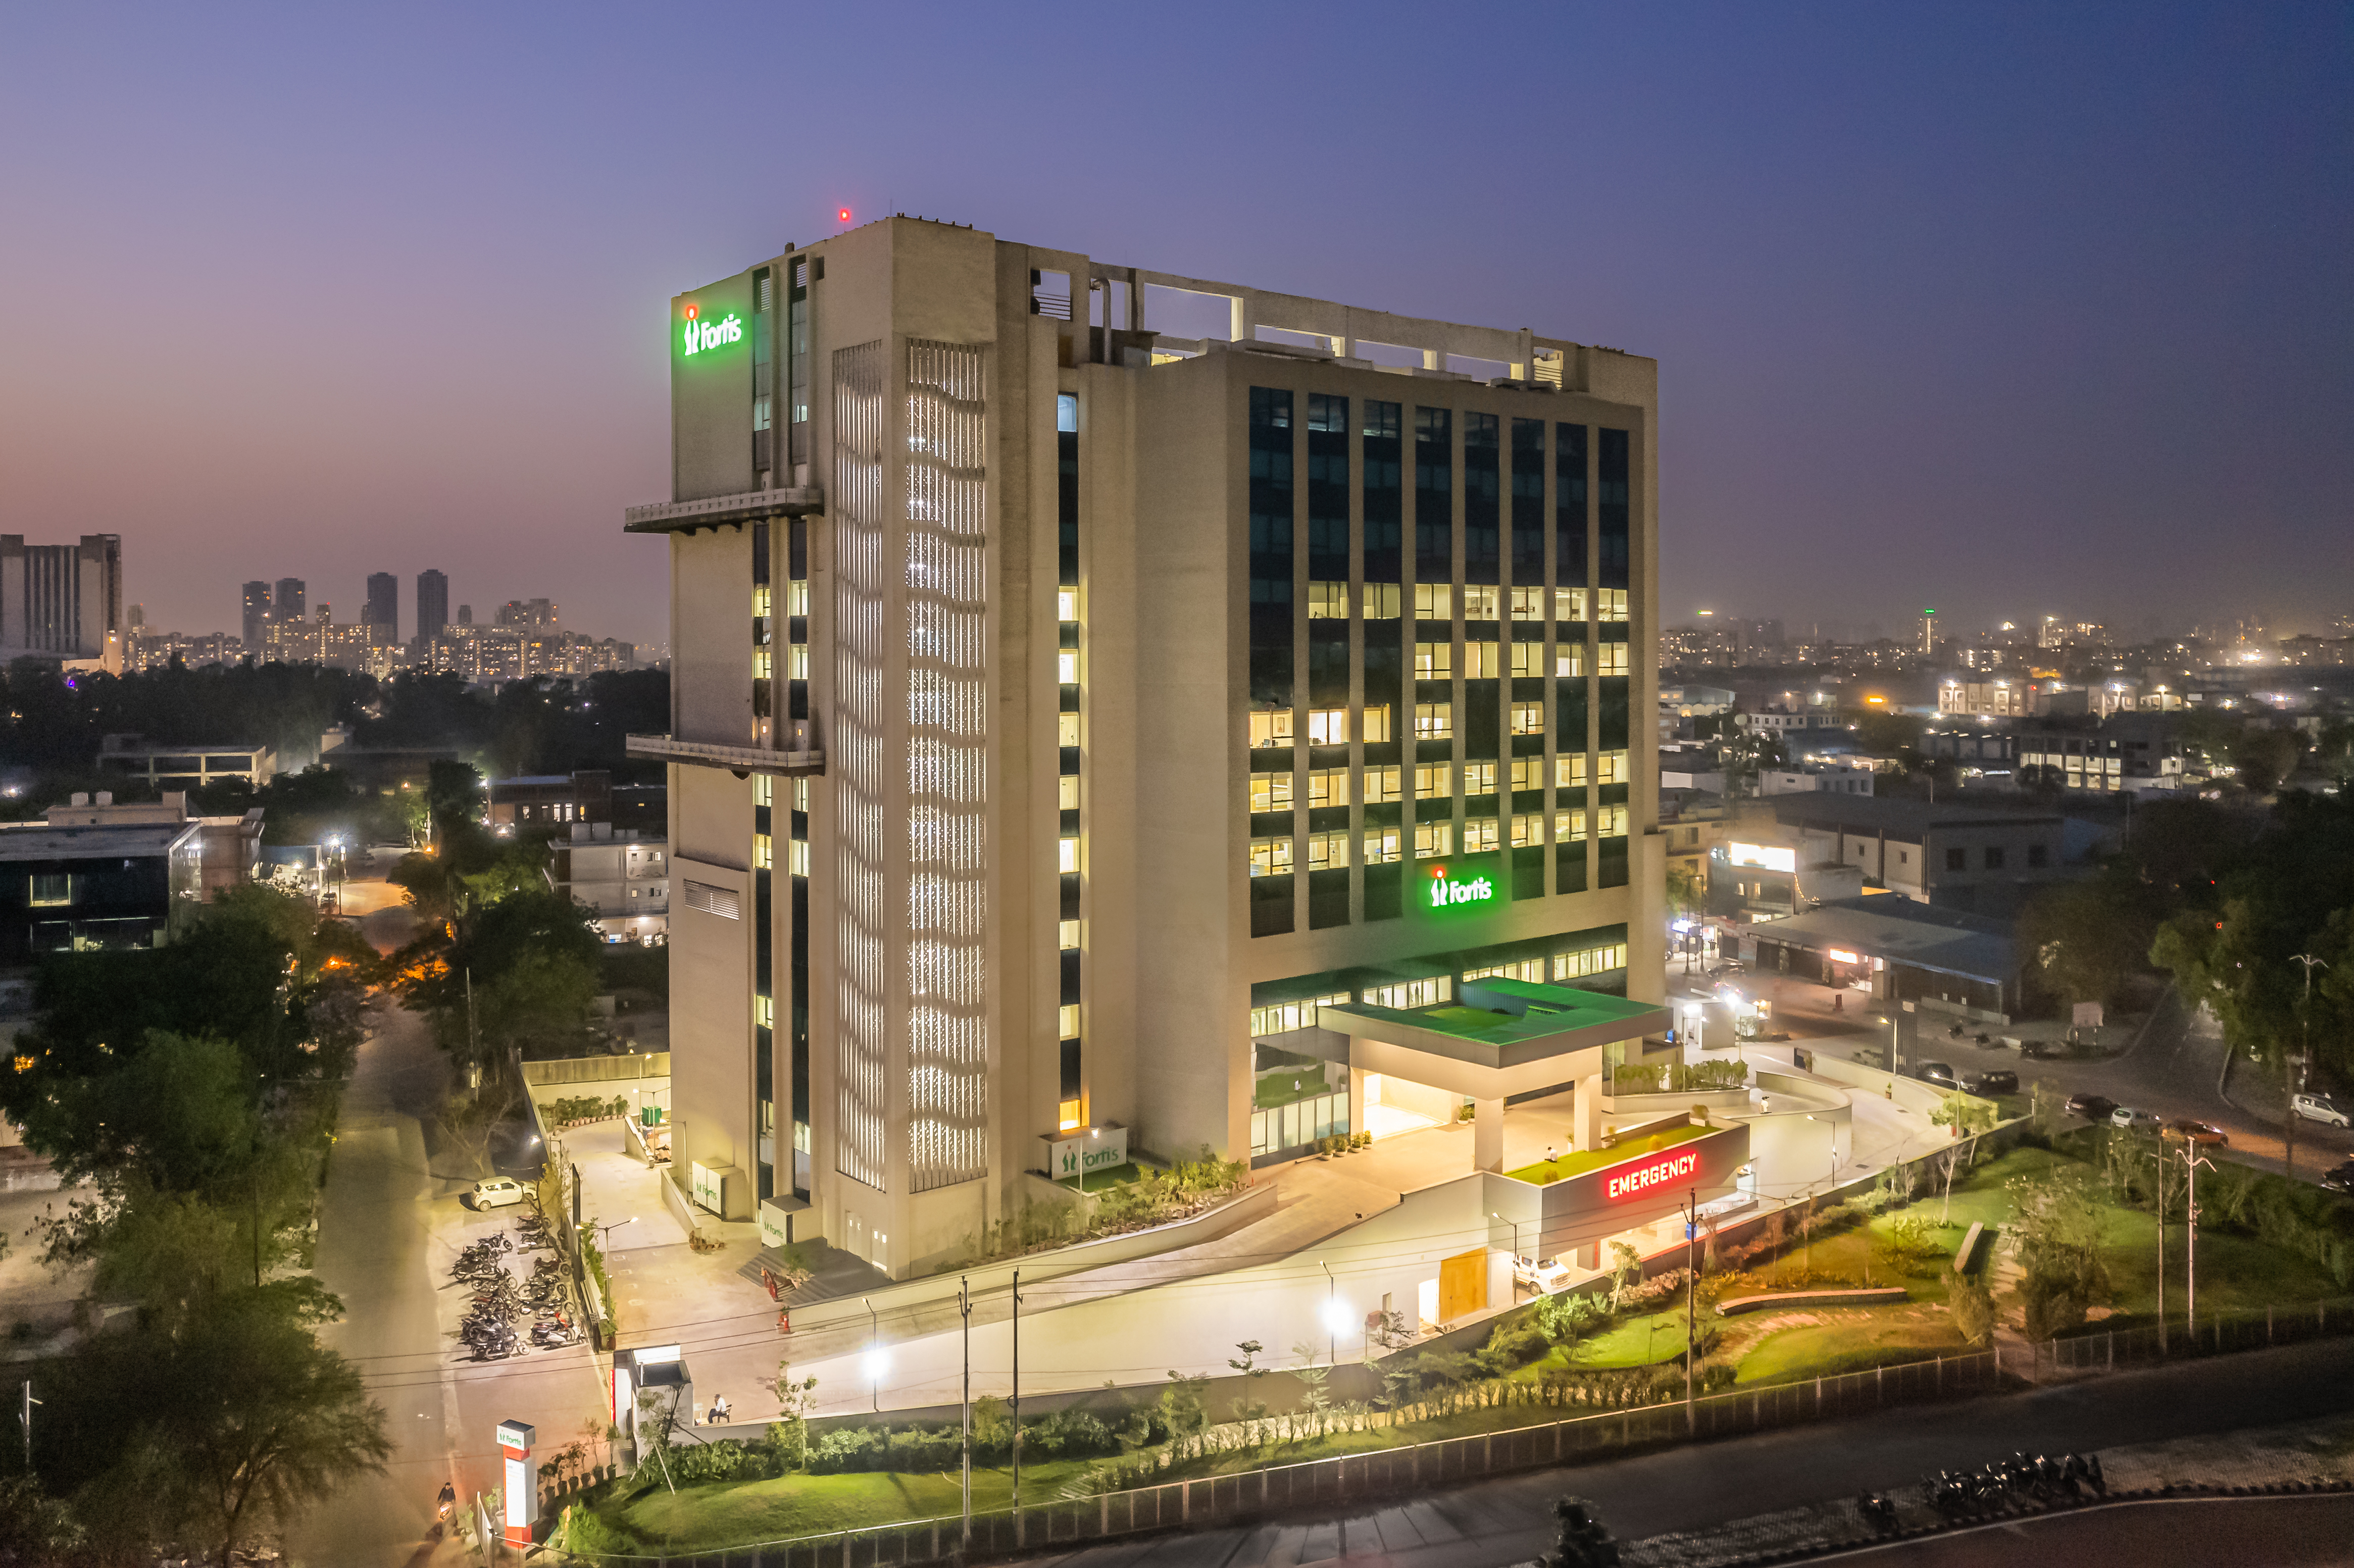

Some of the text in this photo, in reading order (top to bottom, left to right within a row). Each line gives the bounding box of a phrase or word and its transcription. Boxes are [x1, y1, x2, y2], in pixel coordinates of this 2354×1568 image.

[701, 313, 742, 350] Fortis
[1449, 877, 1492, 903] Fortis
[1609, 1153, 1696, 1198] EMERGENCY
